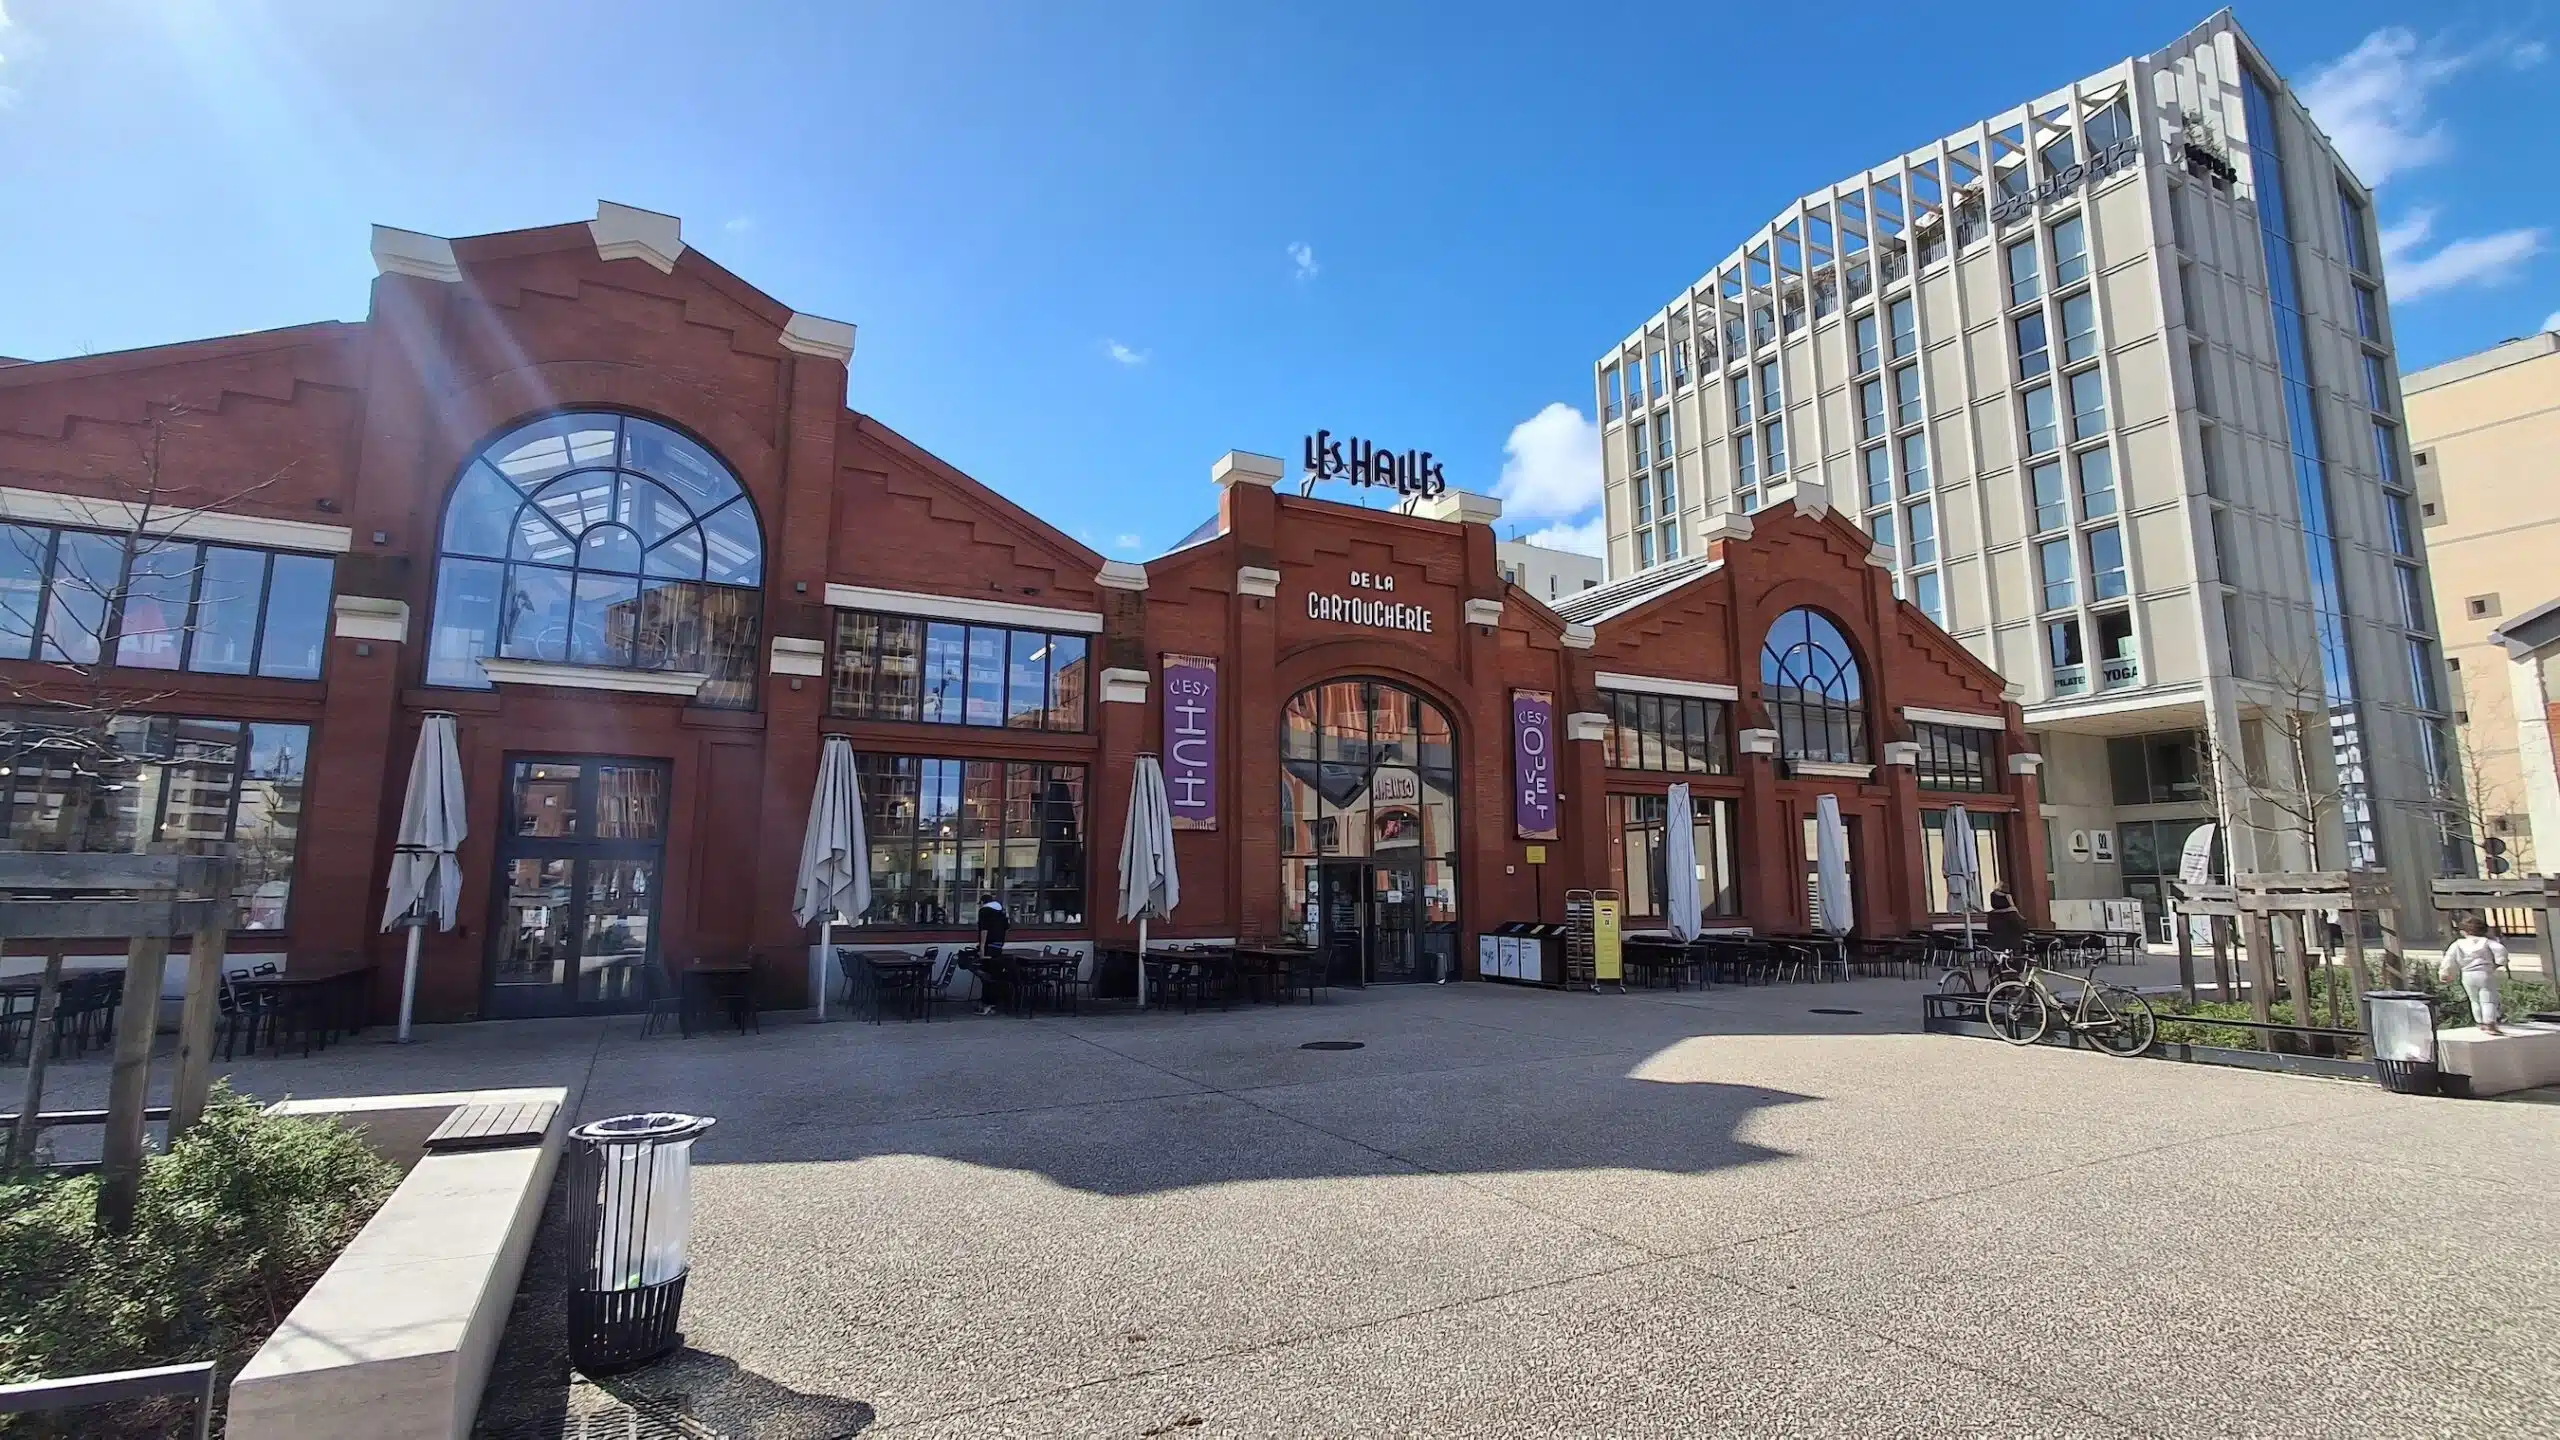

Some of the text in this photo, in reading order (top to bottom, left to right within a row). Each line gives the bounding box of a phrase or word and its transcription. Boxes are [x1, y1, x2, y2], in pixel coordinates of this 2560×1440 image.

[1303, 429, 1446, 500] LES HALLES
[1350, 570, 1394, 591] DE LA
[1308, 591, 1433, 633] CARTOUCHERIE
[2103, 665, 2138, 682] YOGA
[1170, 678, 1210, 696] C'EST
[1518, 710, 1548, 725] C'EST
